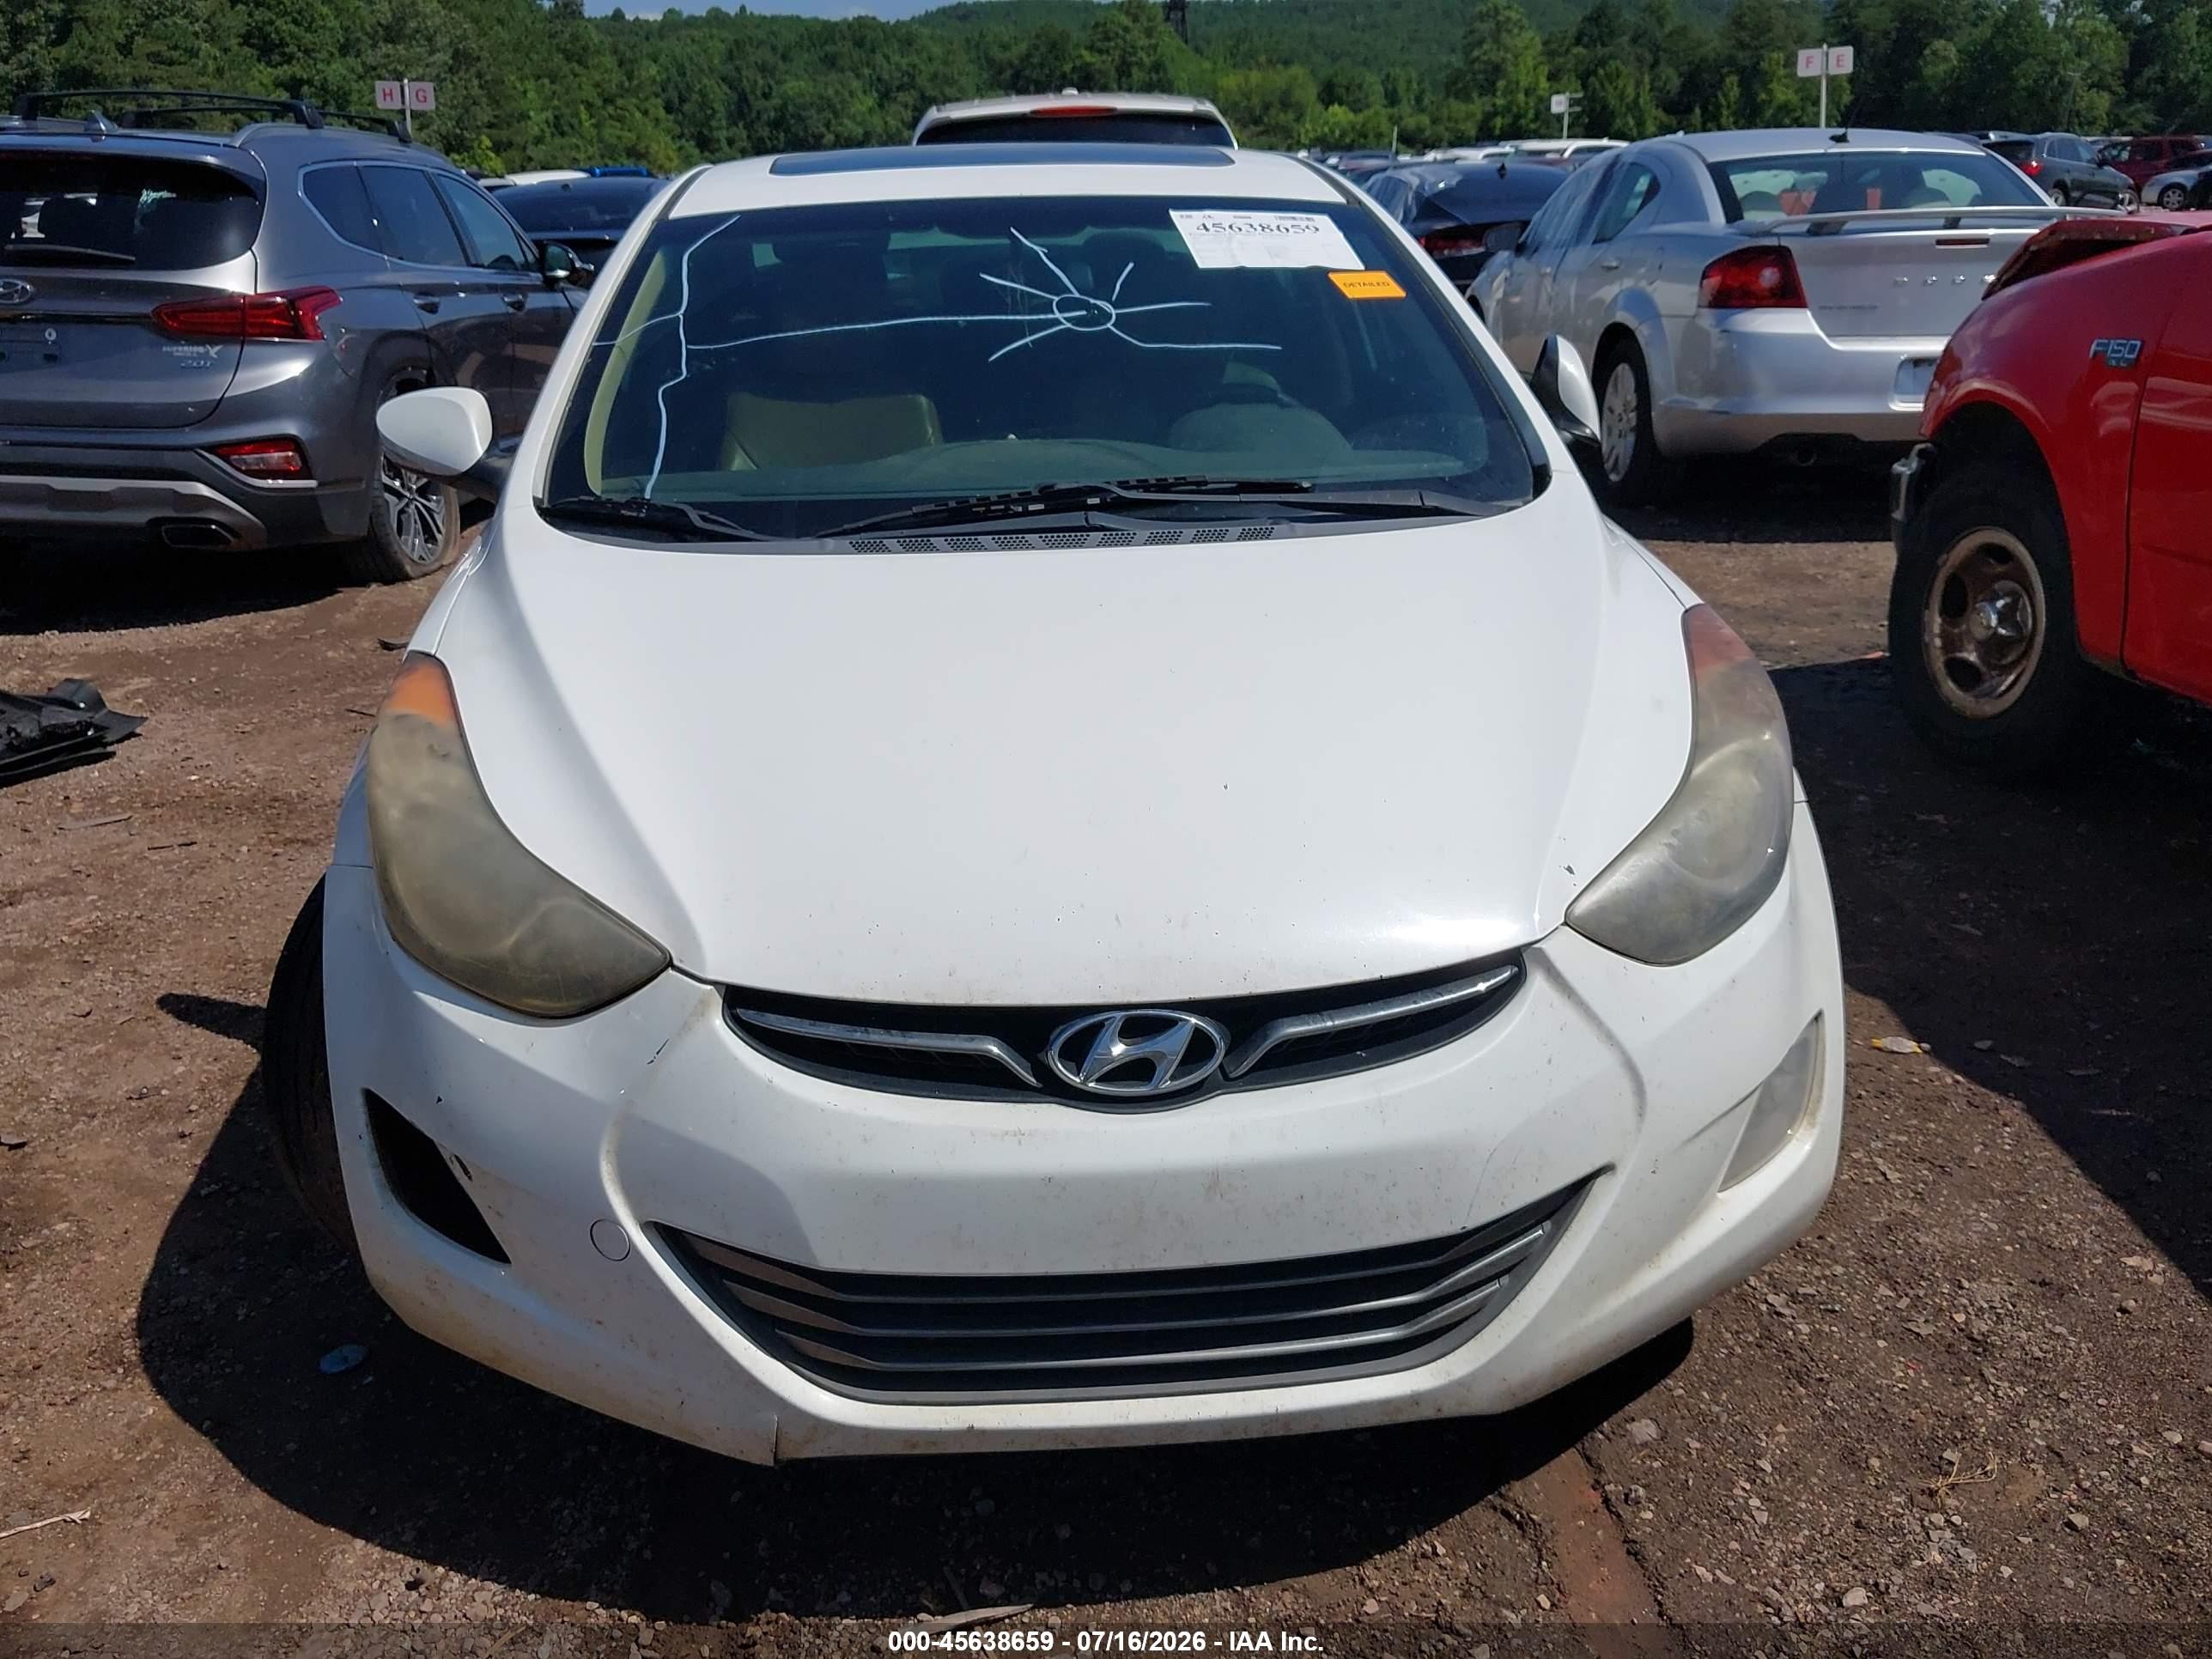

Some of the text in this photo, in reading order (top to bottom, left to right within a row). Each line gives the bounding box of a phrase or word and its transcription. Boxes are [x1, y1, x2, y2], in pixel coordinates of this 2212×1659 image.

[1805, 55, 1814, 69] F
[1836, 54, 1846, 68] E
[382, 88, 394, 102] H
[415, 88, 427, 103] G
[1196, 222, 1320, 234] 45638659
